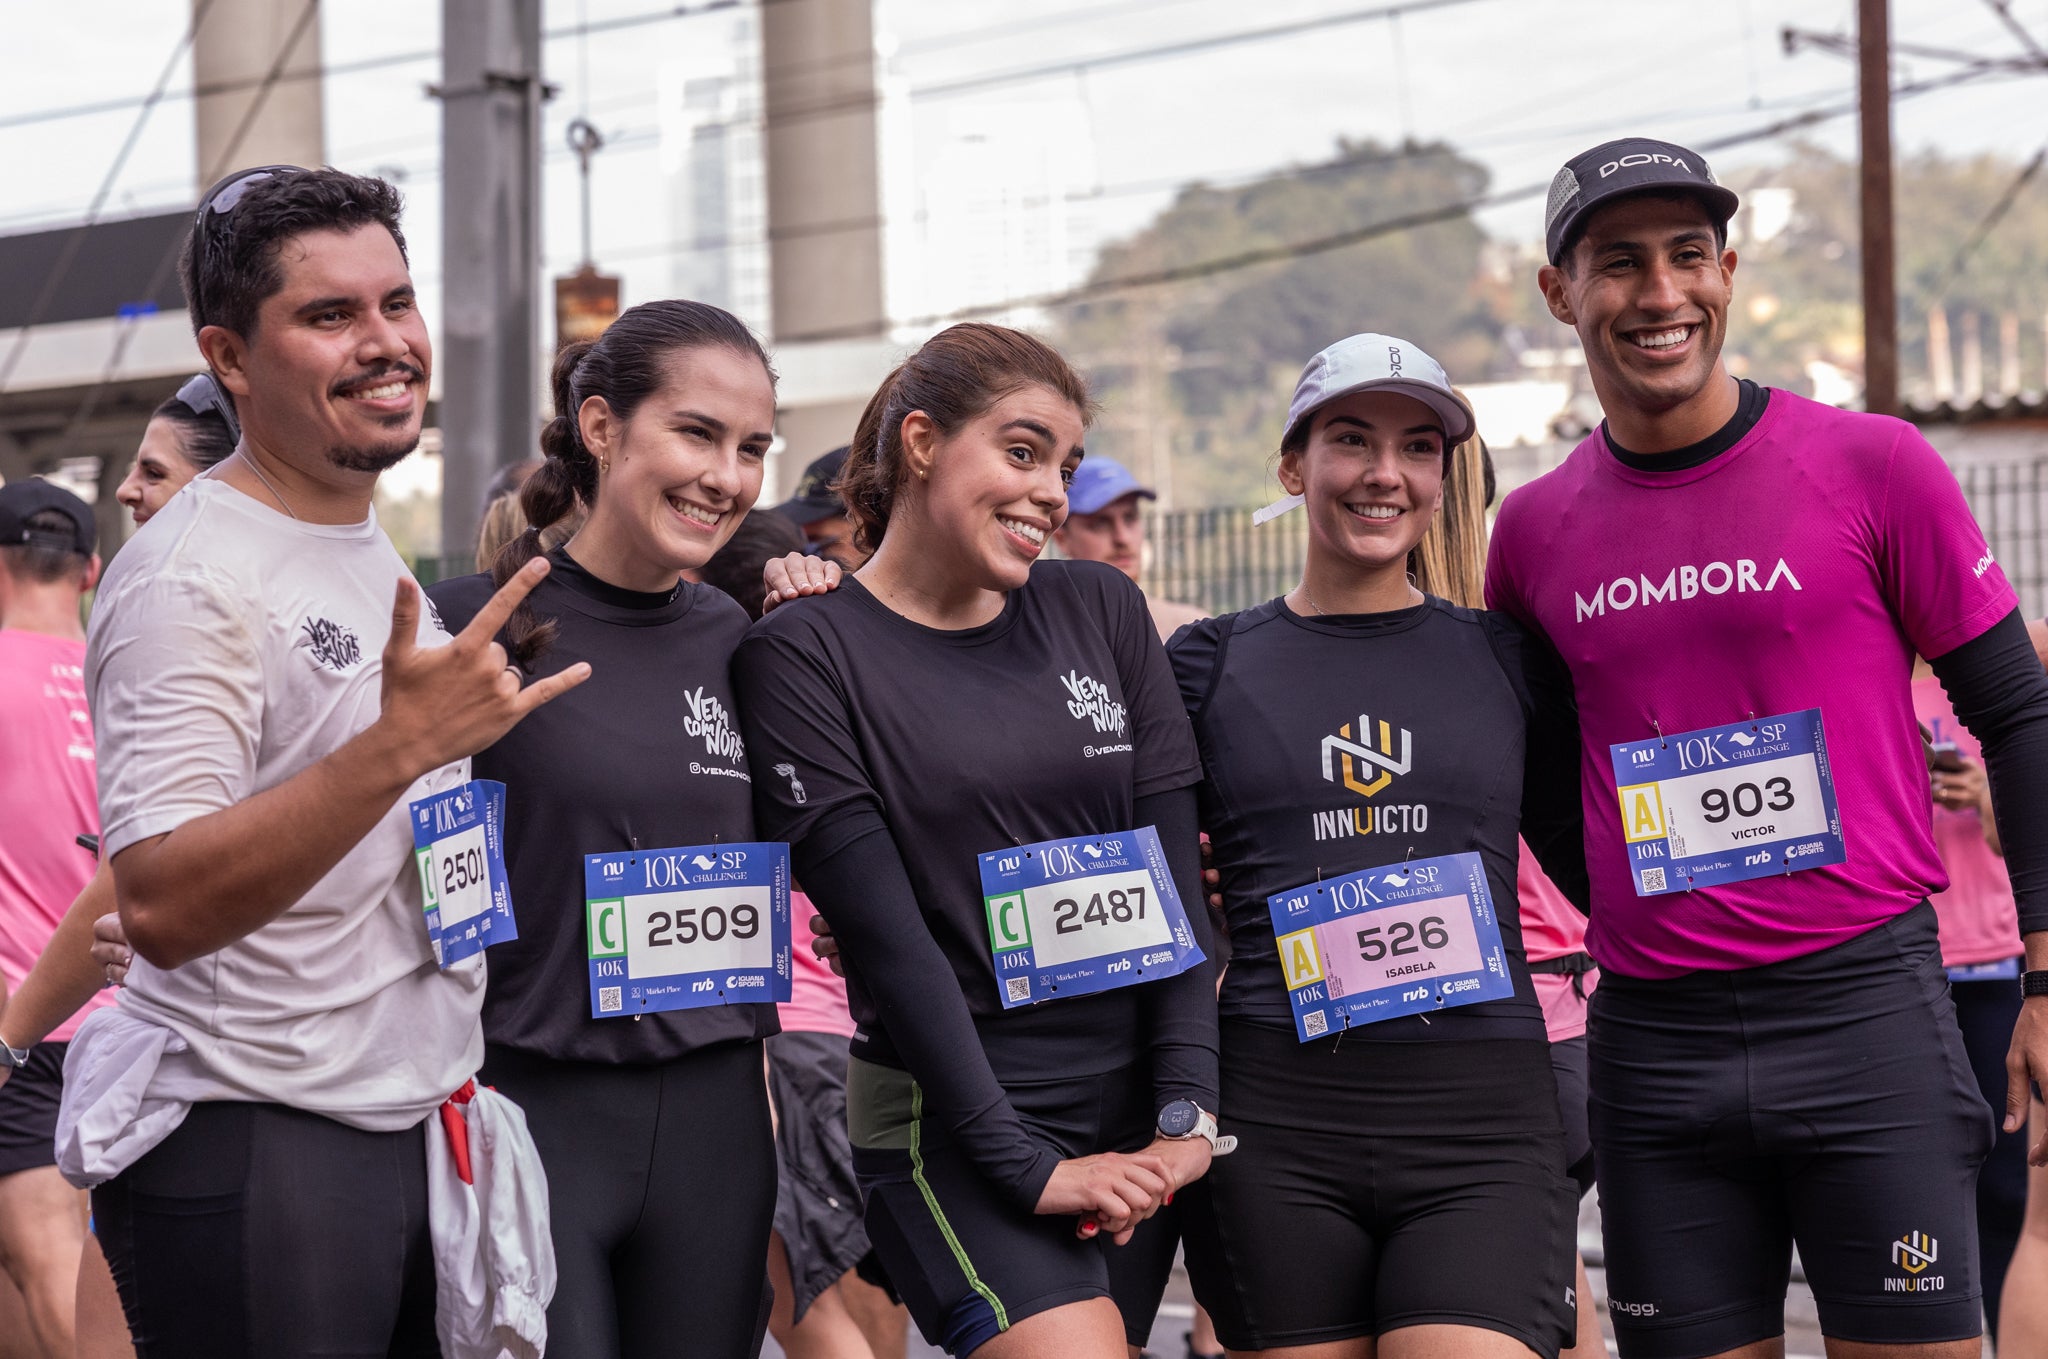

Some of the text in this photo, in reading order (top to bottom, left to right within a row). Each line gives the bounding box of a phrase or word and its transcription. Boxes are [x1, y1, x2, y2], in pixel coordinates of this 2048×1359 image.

[1599, 154, 1692, 178] DOPA
[1389, 347, 1402, 378] DOPA
[1575, 558, 1802, 623] MOMBORA
[1676, 723, 1786, 770] 10K SP
[1732, 742, 1790, 760] CHALLENGE
[1700, 776, 1795, 824] 903
[435, 797, 457, 834] 10K
[1635, 793, 1657, 833] A
[1731, 824, 1776, 841] VICTOR
[1636, 842, 1665, 860] 10K
[1797, 841, 1823, 850] IGUANA
[1798, 847, 1824, 856] SPORTS
[1039, 840, 1122, 878] 10K SP
[1088, 858, 1130, 870] CHALLENGE
[1745, 850, 1771, 866] rvb
[443, 845, 484, 895] 2501
[644, 852, 747, 888] 10K SP
[1692, 862, 1733, 874] Market Place
[425, 856, 434, 899] C
[692, 872, 748, 883] CHALLENGE
[1330, 866, 1439, 914] 10K SP
[1386, 884, 1444, 900] CHALLENGE
[1053, 887, 1146, 935] 2487
[598, 907, 616, 949] C
[647, 904, 760, 948] 2509
[1000, 902, 1019, 942] C
[1356, 916, 1450, 962] 526
[1002, 950, 1030, 970] 10K
[1152, 950, 1172, 958] IGUANA
[1152, 956, 1174, 964] SPORTS
[1293, 940, 1315, 980] A
[596, 960, 624, 977] 10K
[1108, 958, 1131, 974] rvb
[1386, 961, 1436, 979] ISABELA
[1056, 970, 1095, 981] Market Place
[1454, 978, 1479, 987] IGUANA
[646, 987, 666, 995] Market
[692, 978, 715, 992] rvb
[1402, 986, 1428, 1002] rvb
[1455, 984, 1480, 992] SPORTS
[1296, 984, 1324, 1006] 10K
[1350, 999, 1390, 1012] Market Place
